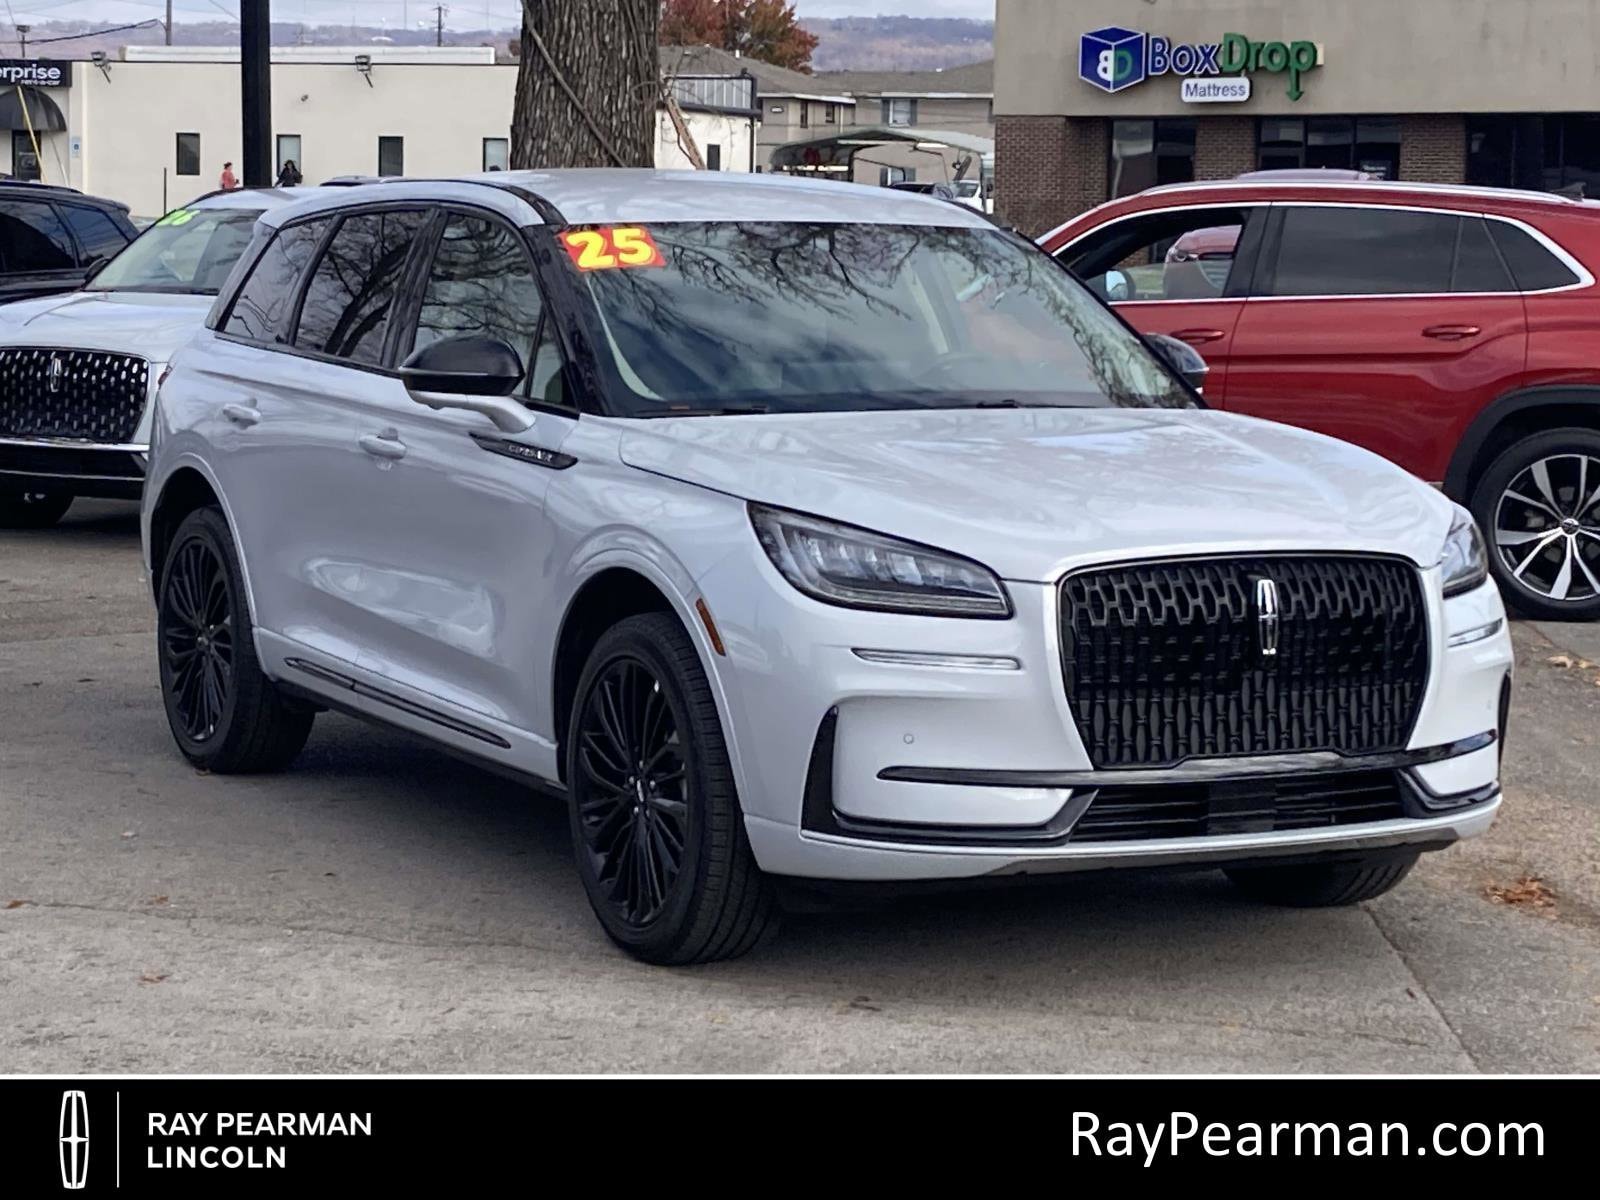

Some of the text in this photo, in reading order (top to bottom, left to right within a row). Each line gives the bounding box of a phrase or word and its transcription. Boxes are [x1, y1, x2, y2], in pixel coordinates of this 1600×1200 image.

[0, 63, 61, 83] rprise
[1149, 32, 1318, 101] BoxDrop
[1184, 83, 1247, 98] Mattress
[565, 227, 656, 268] 25
